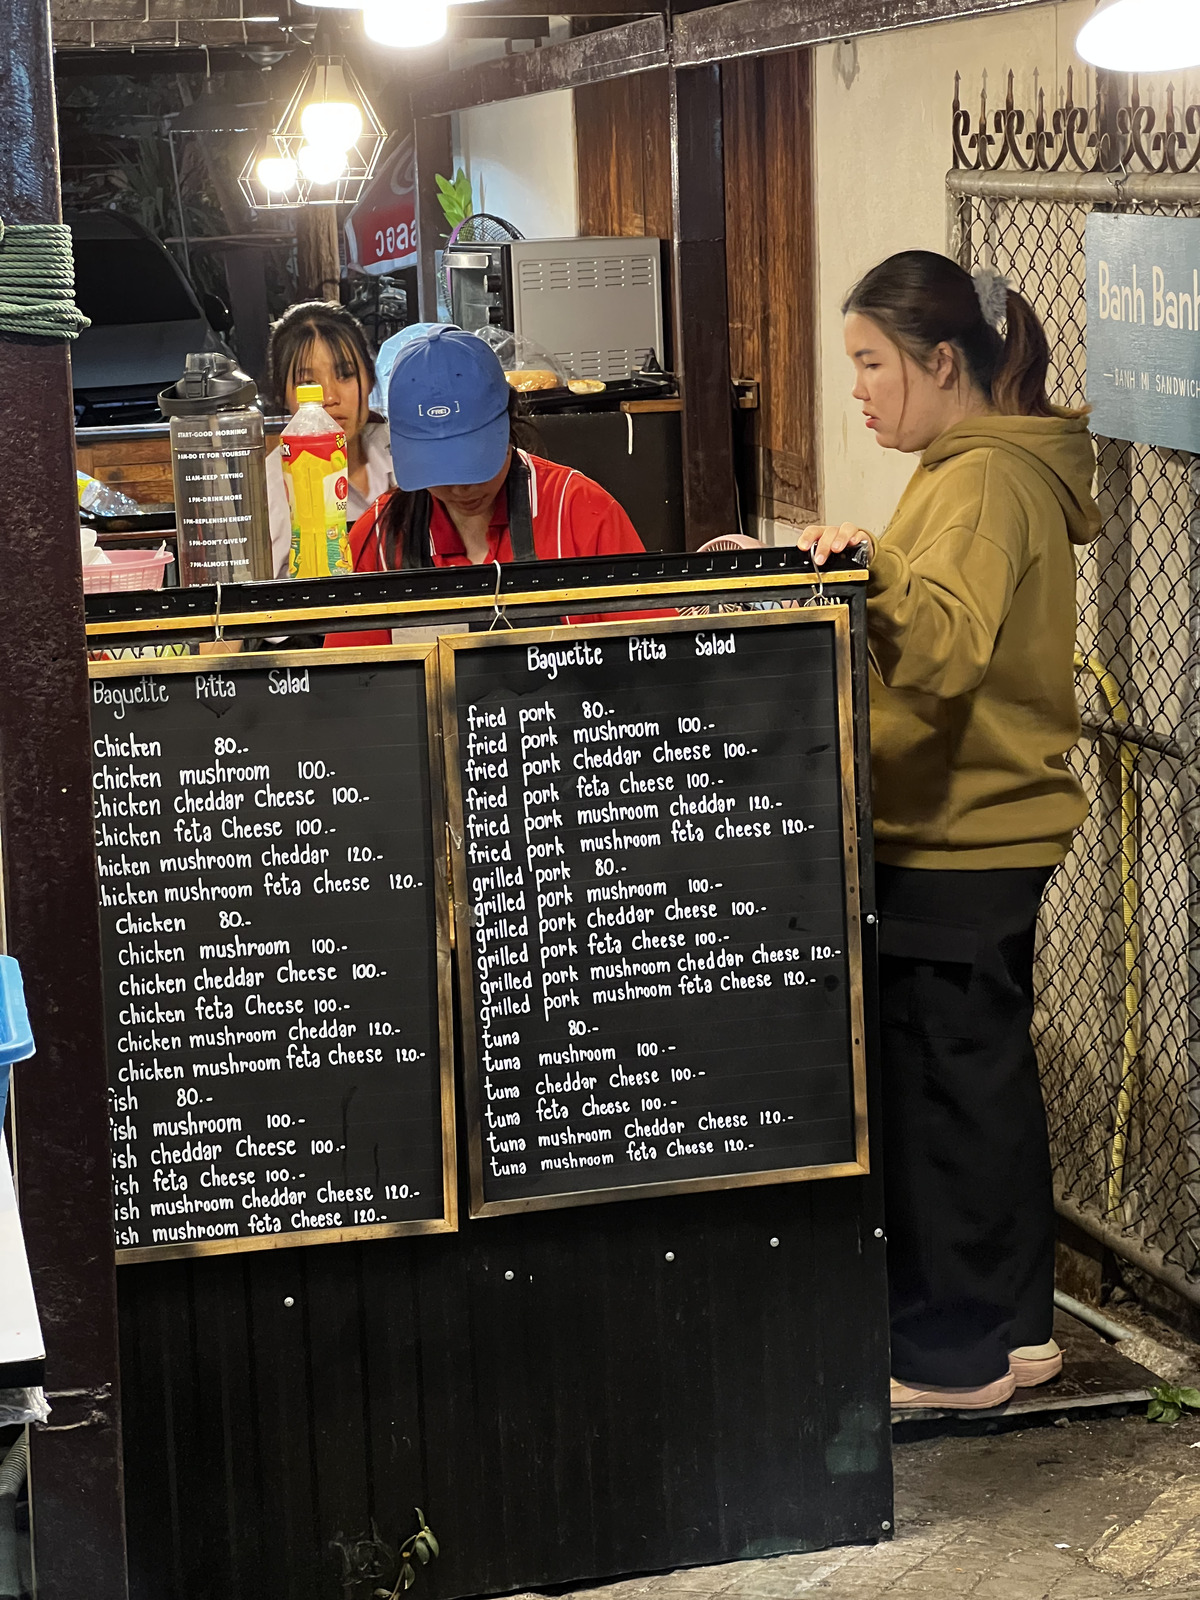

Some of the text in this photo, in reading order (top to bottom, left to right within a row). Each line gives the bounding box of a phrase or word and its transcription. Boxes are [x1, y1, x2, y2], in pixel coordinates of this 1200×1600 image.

[1098, 260, 1146, 325] Banh
[1140, 372, 1150, 391] MI
[220, 472, 244, 480] TRYING
[527, 632, 736, 680] Baguette Pitta Salad
[93, 668, 310, 720] Baguette Pitta Salad
[466, 700, 615, 734] fried pork 80.-
[214, 736, 249, 756] 80.-
[466, 716, 716, 761] fried pork mushroom 100.-
[179, 758, 336, 787] mushroom 100.-
[464, 757, 509, 782] fried
[522, 751, 561, 787] pork
[723, 742, 758, 759] 100.-
[332, 786, 370, 806] 100.-
[465, 772, 724, 818] fried pork feta 100.-
[173, 817, 212, 844] feta
[295, 818, 337, 837] 100.-
[467, 813, 511, 840] fried
[524, 812, 564, 845] pork
[576, 800, 659, 825] mushroom
[748, 795, 783, 812] 120.-
[97, 853, 151, 877] hicken
[159, 847, 252, 873] mushroom
[347, 846, 384, 863] 120.-
[468, 839, 512, 864] fried
[526, 835, 565, 873] pork
[579, 828, 662, 853] mushroom
[670, 818, 705, 843] feta
[781, 818, 815, 836] 120.-
[98, 871, 423, 907] hicken mushroom feta 120.-
[472, 857, 627, 902] grilled pork 80.-
[218, 910, 252, 929] 80.-
[473, 878, 723, 928] grilled pork mushroom 100.-
[475, 901, 767, 955] grilled pork 100.-
[199, 933, 348, 960] mushroom 100.-
[477, 931, 730, 981] grilled pork feta 100.-
[352, 963, 387, 981] 100.-
[479, 970, 533, 1006] grilled
[542, 964, 579, 997] pork
[589, 956, 671, 981] mushroom
[810, 945, 842, 961] 120.-
[194, 994, 351, 1021] feta 100.-
[479, 992, 531, 1030] grilled
[543, 987, 580, 1022] pork
[592, 980, 672, 1005] mushroom
[677, 973, 713, 996] feta
[783, 970, 817, 987] 120.-
[188, 1024, 277, 1049] mushroom
[368, 1021, 401, 1037] 120.-
[481, 1019, 599, 1049] tuna 80.-
[192, 1051, 281, 1078] mushroom
[285, 1043, 321, 1070] feta
[395, 1048, 426, 1063] 120.-
[481, 1042, 677, 1073] tuna mushroom 100.-
[176, 1087, 213, 1108] 80.-
[483, 1067, 706, 1101] tuna 100.-
[109, 1110, 306, 1142] ish mushroom 100.-
[484, 1096, 678, 1129] tuna feta 100.-
[486, 1131, 527, 1154] tuna
[537, 1125, 612, 1148] mushroom
[759, 1110, 794, 1125] 120.-
[112, 1142, 138, 1169] ish
[310, 1139, 346, 1156] 100.-
[489, 1155, 527, 1177] tuna
[540, 1151, 614, 1171] mushroom
[625, 1140, 658, 1162] feta
[724, 1138, 755, 1153] 120.-
[114, 1168, 306, 1196] ish feta 100.-
[115, 1184, 421, 1222] ish mushroom 120.-
[116, 1202, 388, 1246] ish mushroom feta 120.-
